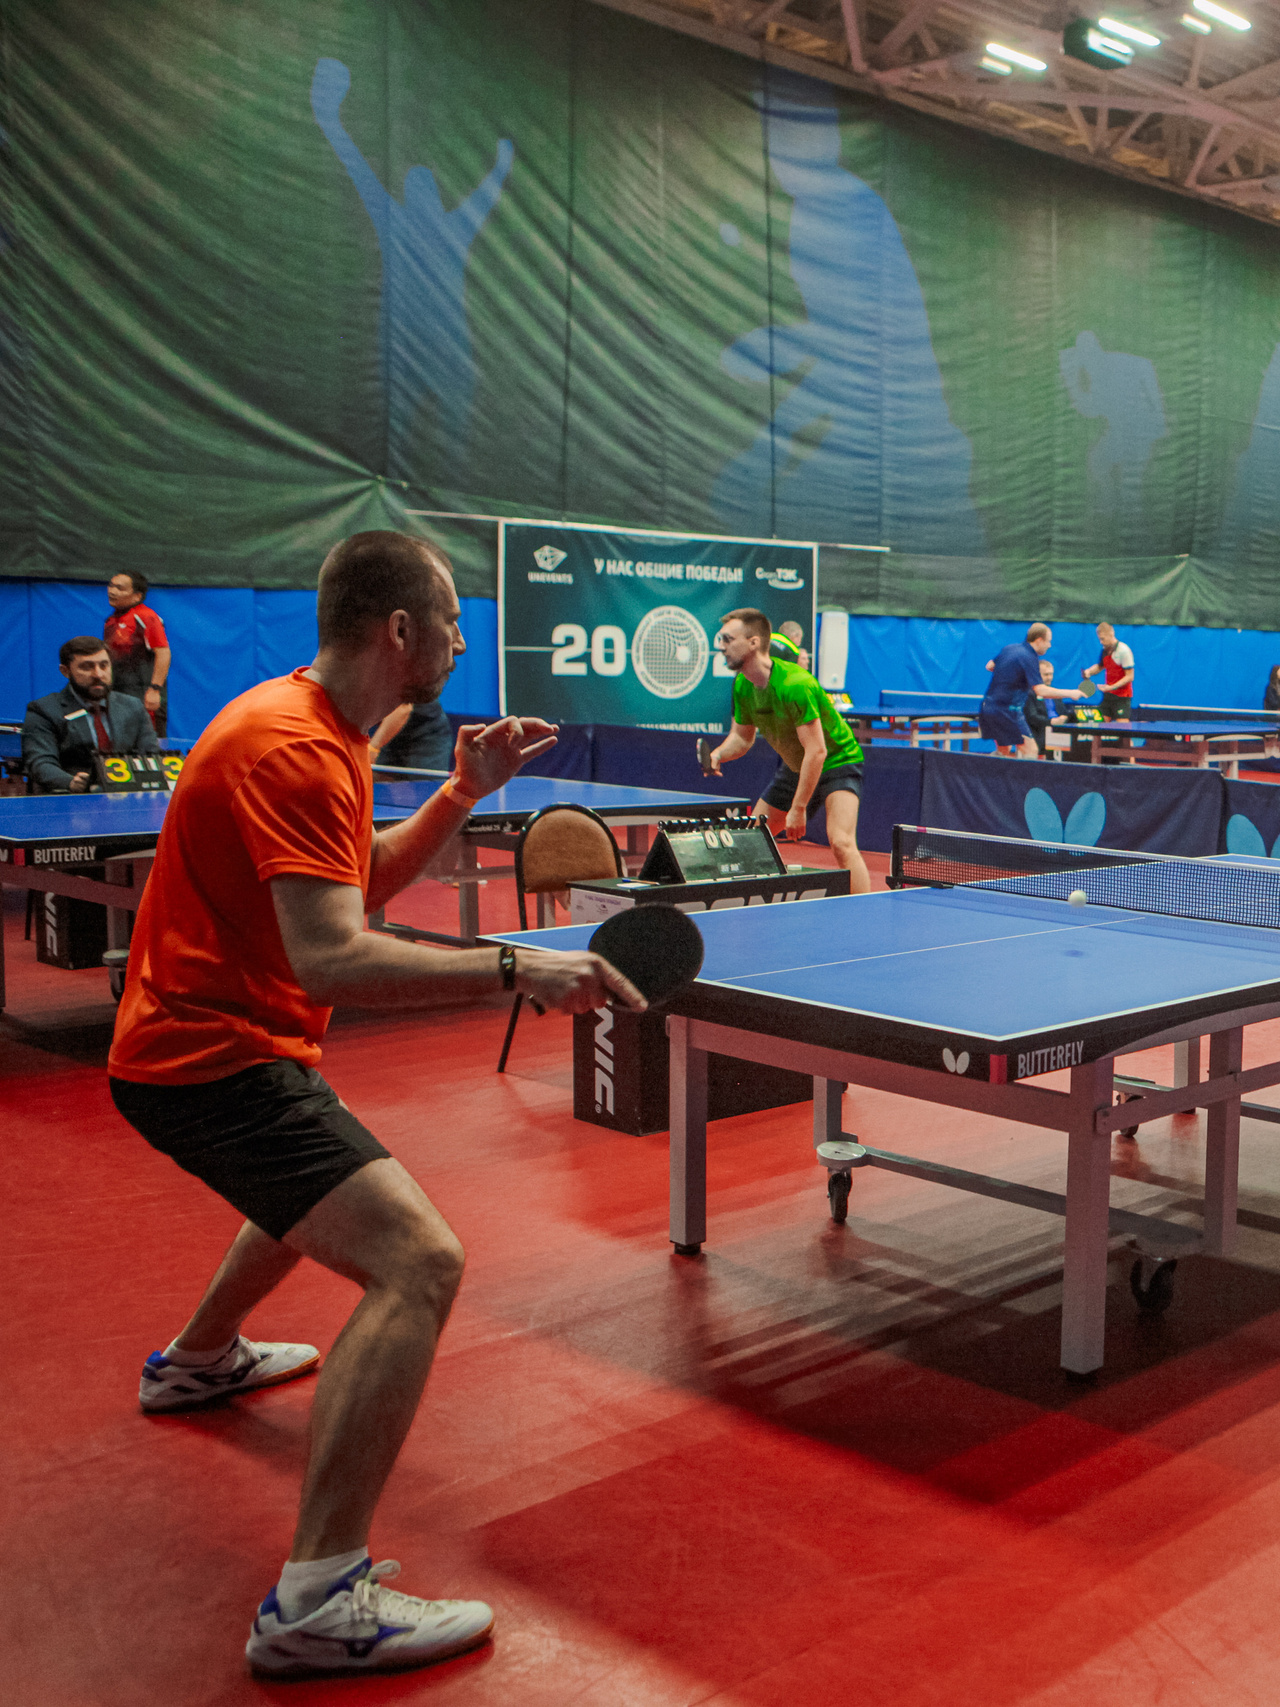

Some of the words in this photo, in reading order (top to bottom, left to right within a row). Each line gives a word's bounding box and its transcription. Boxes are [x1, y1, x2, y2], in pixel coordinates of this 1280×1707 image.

[594, 558, 605, 574] У
[606, 559, 634, 577] НАС
[635, 561, 684, 580] ОБЩИЕ
[685, 564, 744, 584] ПОБЕДЫ!
[104, 757, 133, 783] 3
[34, 846, 97, 864] BUTTERFLY
[1018, 1041, 1084, 1079] BUTTERFLY
